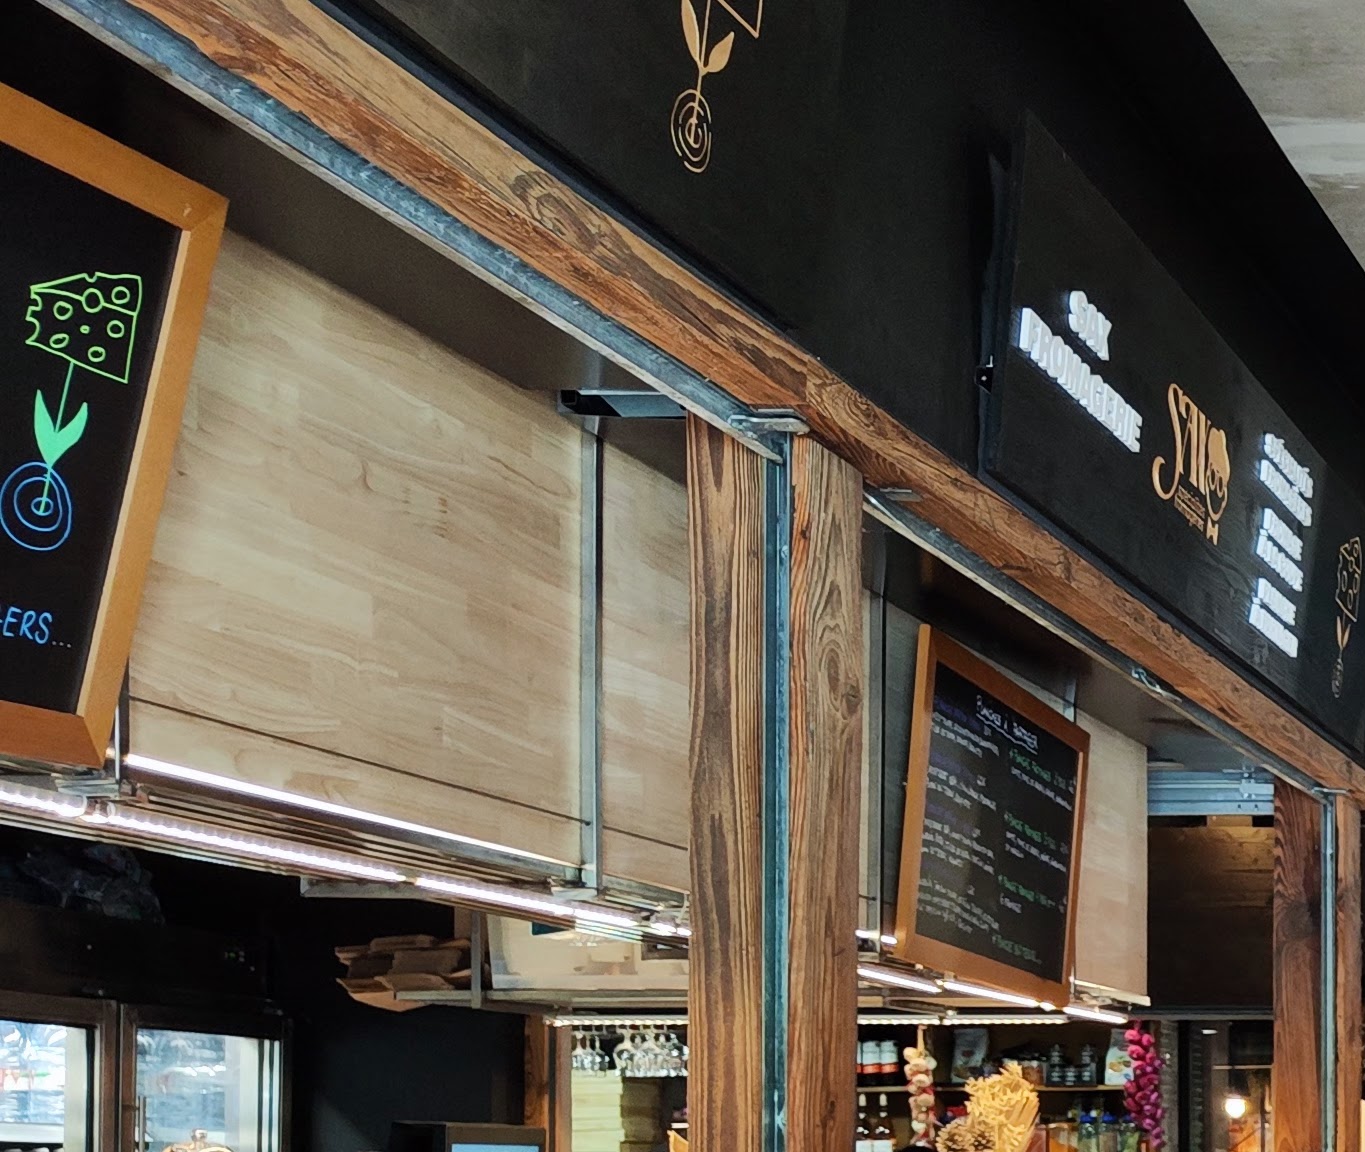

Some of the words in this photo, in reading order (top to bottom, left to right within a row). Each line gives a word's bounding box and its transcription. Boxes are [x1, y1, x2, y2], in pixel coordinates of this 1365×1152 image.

[1068, 290, 1112, 361] SAX
[1019, 307, 1143, 453] FROMAGERIE
[0, 606, 72, 648] ERS...
